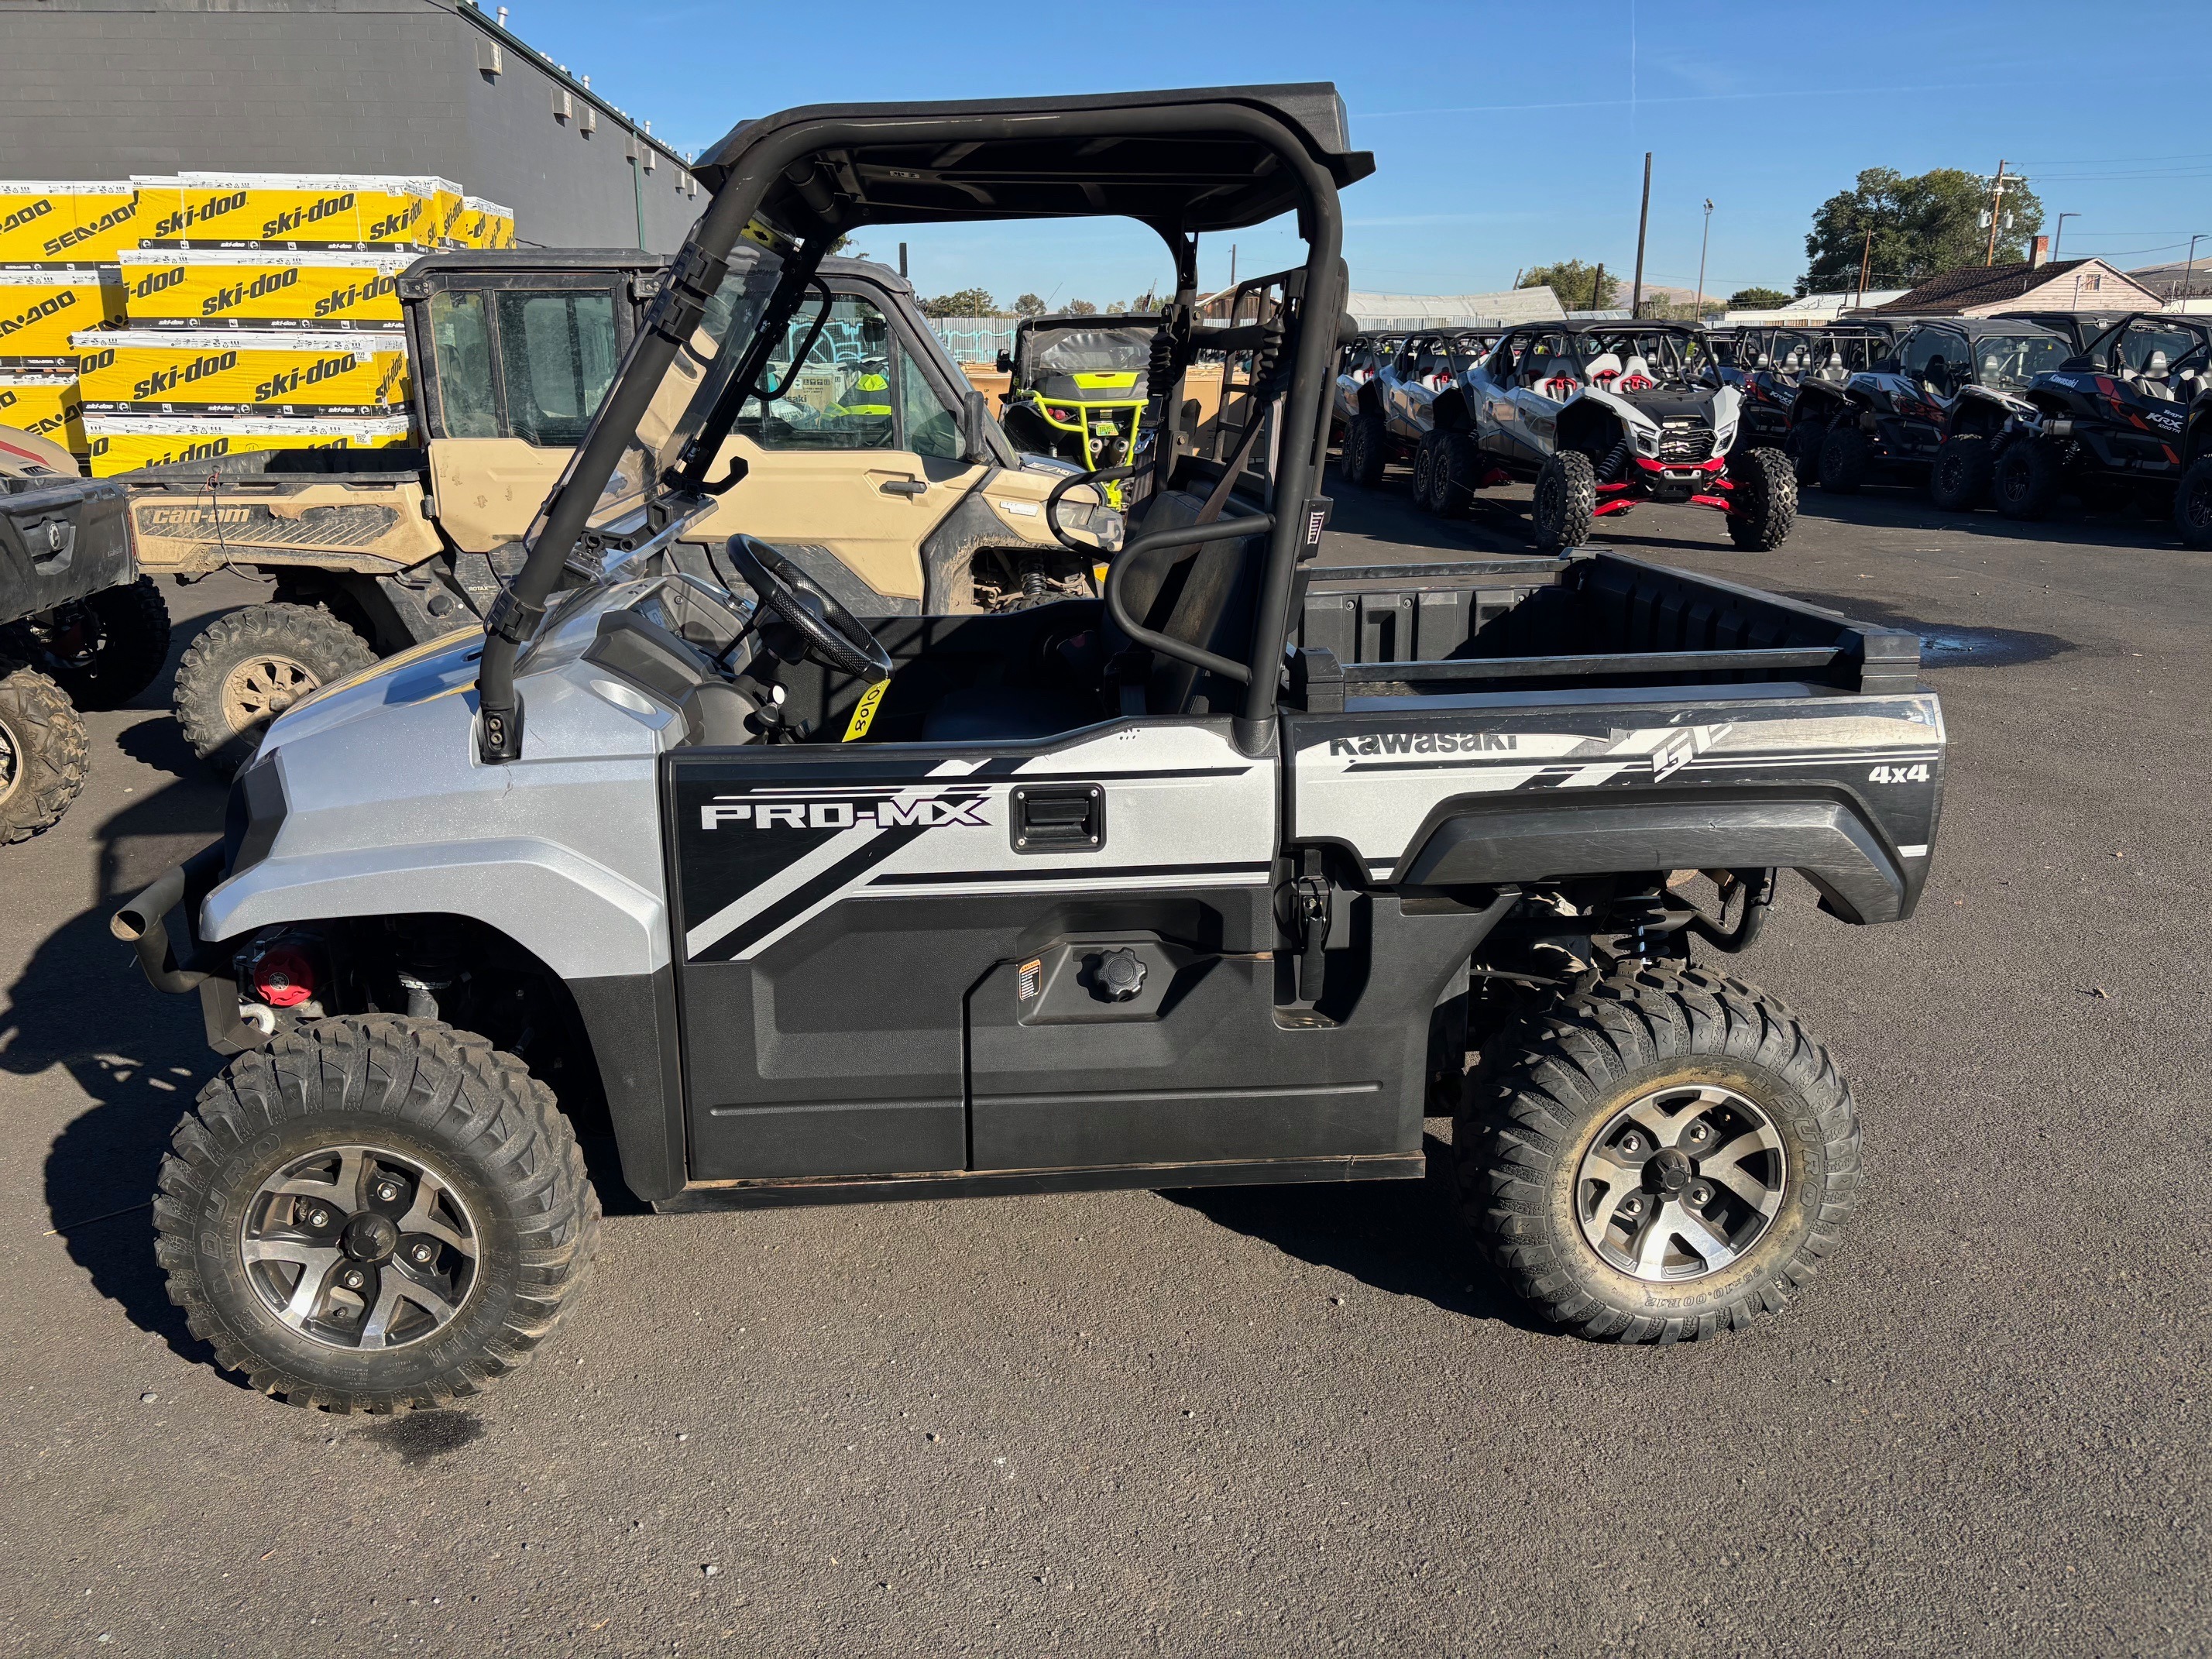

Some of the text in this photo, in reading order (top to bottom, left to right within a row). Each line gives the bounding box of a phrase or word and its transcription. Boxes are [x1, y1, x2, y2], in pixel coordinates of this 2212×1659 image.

[155, 191, 247, 238] ski-doo
[262, 193, 355, 239] ski-doo
[202, 268, 298, 316] ski-doo
[314, 276, 395, 317] ski-do
[133, 351, 237, 400] ski-doo
[255, 353, 357, 402] ski-doo
[2049, 373, 2079, 388] Kawasaki
[2145, 412, 2184, 430] KRX
[153, 508, 250, 524] can-am
[855, 689, 881, 732] 8010
[1868, 764, 1930, 784] 4x4
[700, 799, 994, 830] PRO-MX
